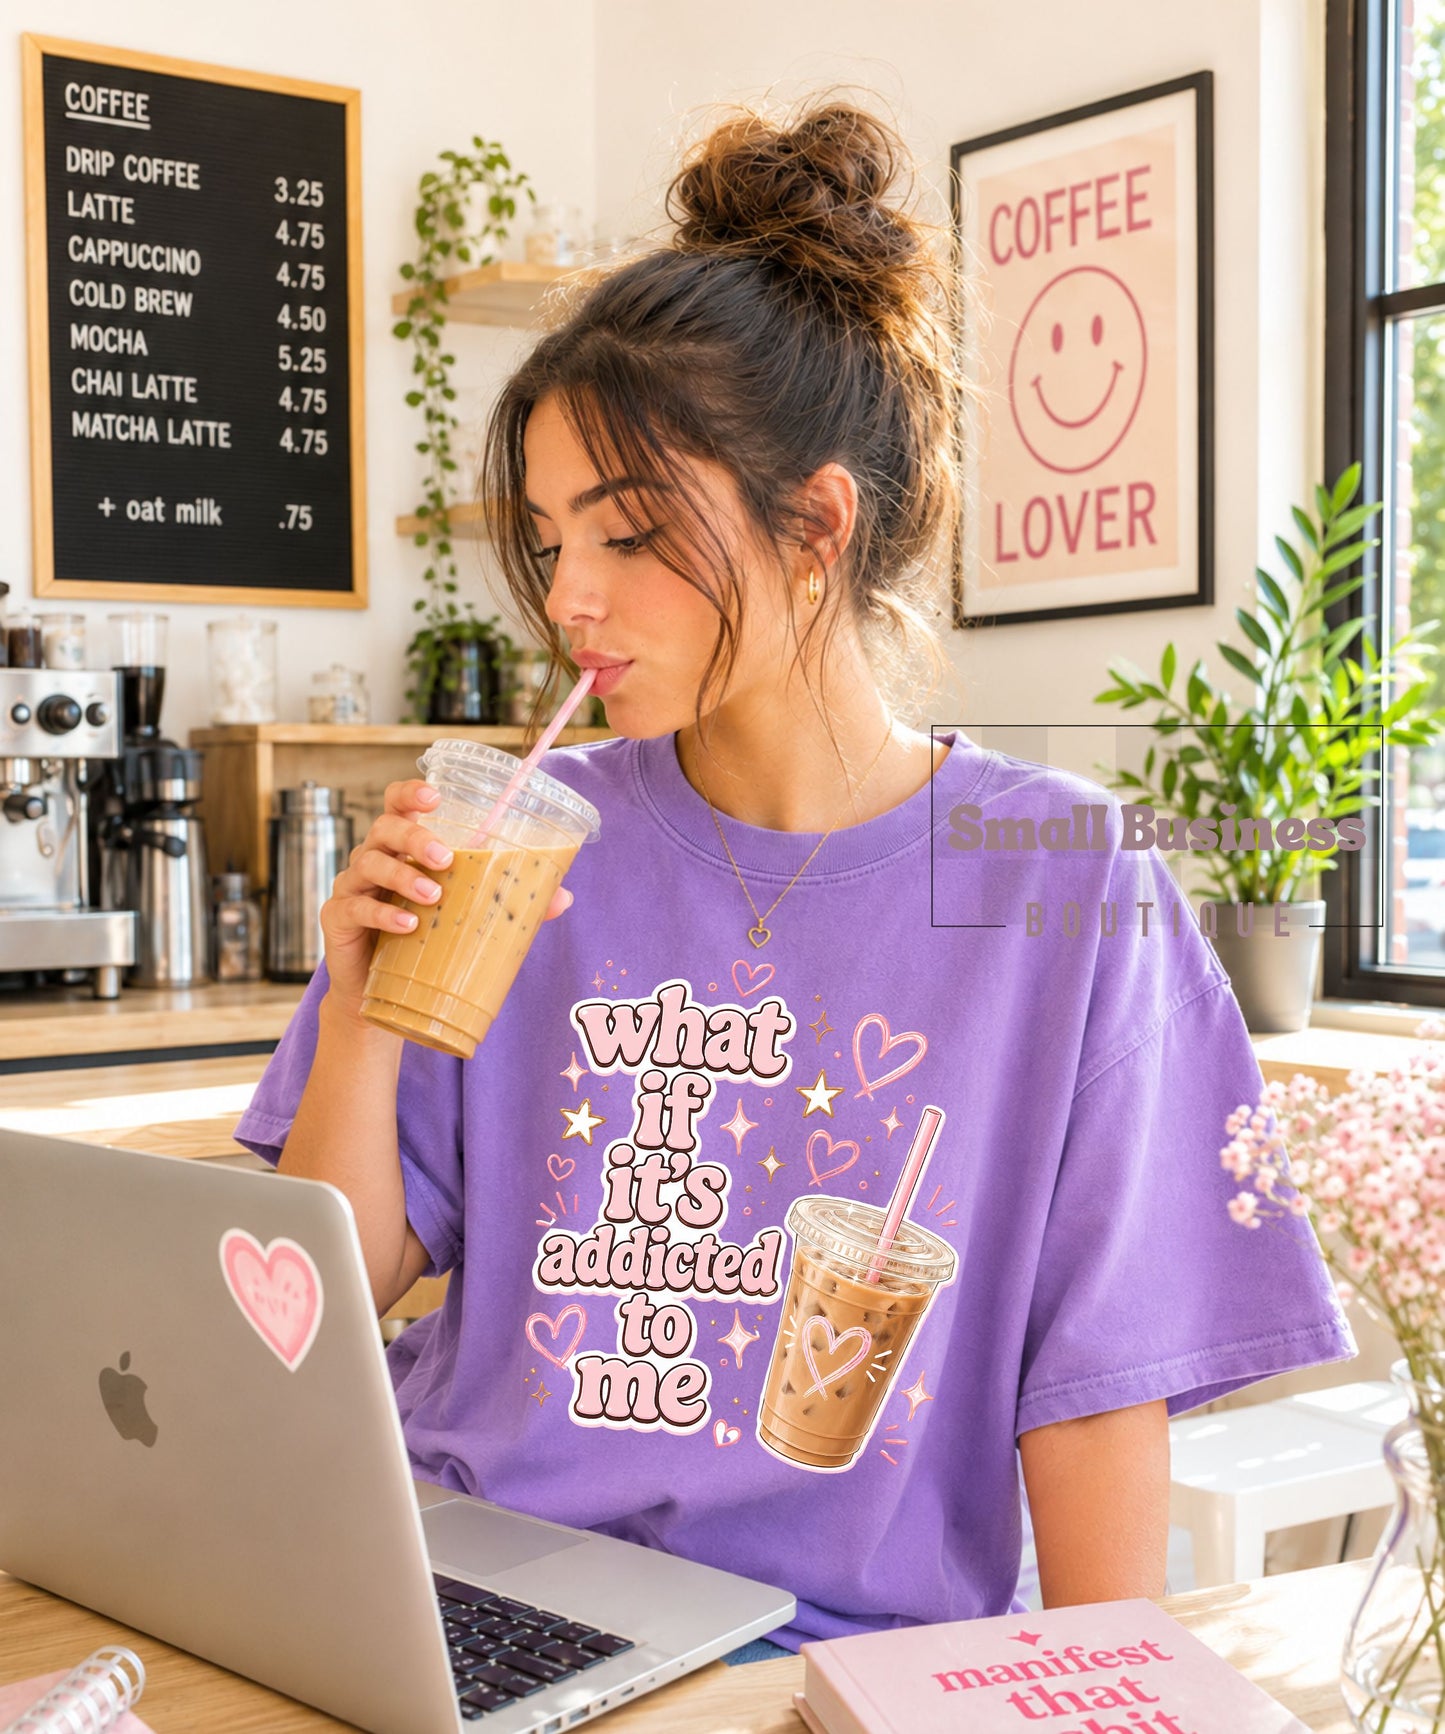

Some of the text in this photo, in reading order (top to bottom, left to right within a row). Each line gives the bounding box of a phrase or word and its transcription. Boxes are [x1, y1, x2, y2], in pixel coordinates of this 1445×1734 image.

[64, 82, 150, 122] COFFEE
[66, 146, 201, 190] DRIP COFFEE
[67, 190, 136, 225] LATTE
[274, 176, 324, 207] 3.25
[275, 219, 325, 250] 4.75
[988, 164, 1153, 267] COFFEE
[68, 235, 201, 277] CAPPUCCINO
[276, 261, 326, 291] 4.75
[69, 279, 194, 318] COLD BREW
[277, 303, 327, 332] 4.50
[70, 323, 149, 357] MOCHA
[278, 344, 327, 374] 5.25
[71, 368, 198, 403] CHAI LATTE
[278, 386, 328, 414] 4.75
[71, 410, 232, 449] MATCHA LATTE
[279, 427, 328, 455] 4.75
[97, 496, 223, 526] + oat milk
[278, 504, 313, 531] .75
[994, 480, 1158, 565] LOVER
[575, 984, 792, 1078] what
[636, 1069, 712, 1151] if
[603, 1143, 727, 1227] it's
[537, 1224, 781, 1297] addicted
[619, 1292, 693, 1358] to
[574, 1356, 707, 1427] me
[931, 1638, 1175, 1692] manifest
[1006, 1675, 1161, 1720] that
